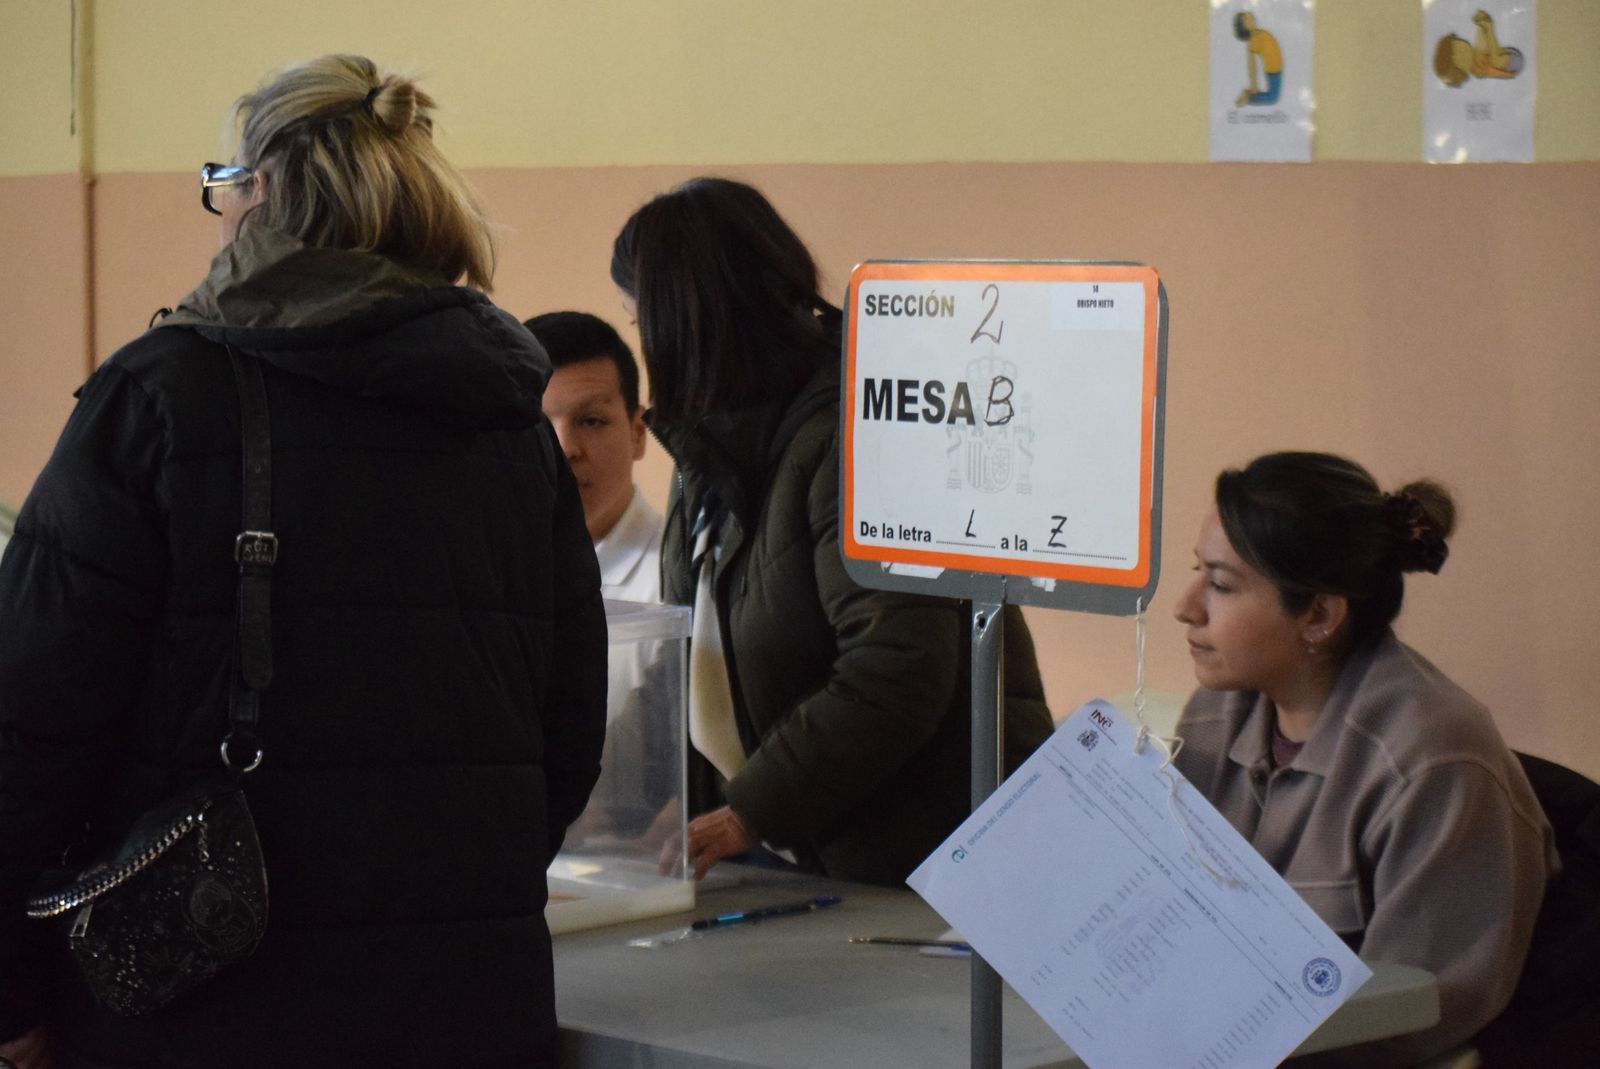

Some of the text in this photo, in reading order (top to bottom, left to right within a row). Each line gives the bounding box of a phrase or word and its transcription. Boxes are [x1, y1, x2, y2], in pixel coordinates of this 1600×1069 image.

[864, 284, 1004, 345] SECCIÓN 2
[862, 376, 1015, 427] MESA B
[860, 508, 1068, 552] De la letra L a la Z
